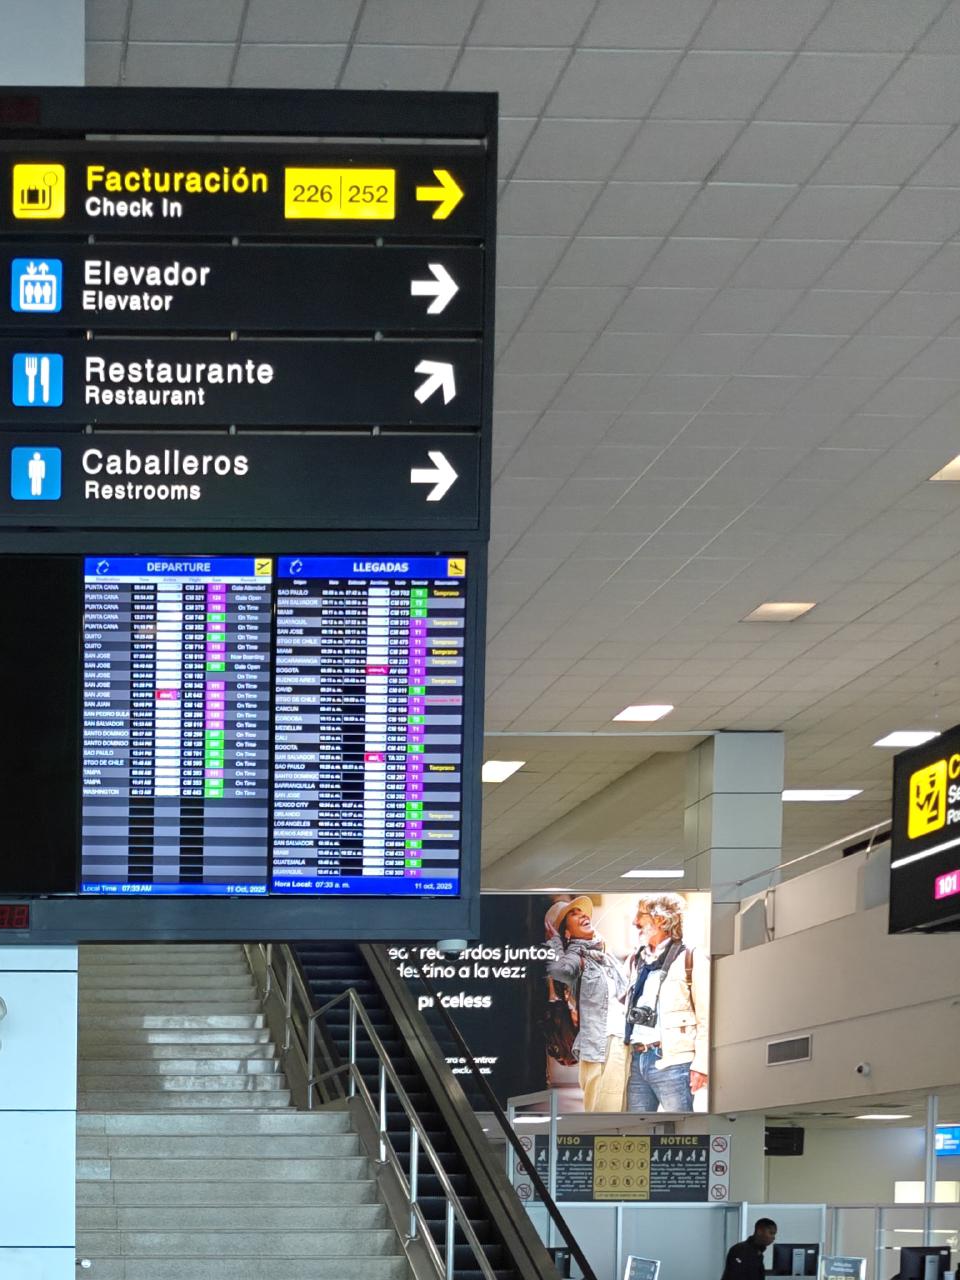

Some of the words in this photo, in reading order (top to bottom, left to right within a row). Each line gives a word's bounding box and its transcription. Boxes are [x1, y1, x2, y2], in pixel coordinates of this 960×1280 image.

[87, 166, 268, 193] Facturación
[292, 184, 333, 203] 226
[348, 185, 389, 204] 252
[85, 198, 153, 218] Check
[163, 199, 182, 218] In
[84, 261, 210, 286] Elevador
[82, 292, 173, 311] Elevator
[86, 358, 274, 384] Restaurante
[85, 385, 205, 405] Restaurant
[82, 450, 249, 475] Caballeros
[85, 481, 201, 501] Restrooms
[147, 562, 211, 572] DEPARTURE
[353, 563, 408, 572] LLEGADAS
[938, 874, 958, 896] 101
[504, 944, 560, 964] juntos,
[458, 966, 469, 978] a
[474, 963, 488, 978] la
[491, 966, 526, 978] vez:
[660, 1137, 698, 1145] NOTICE
